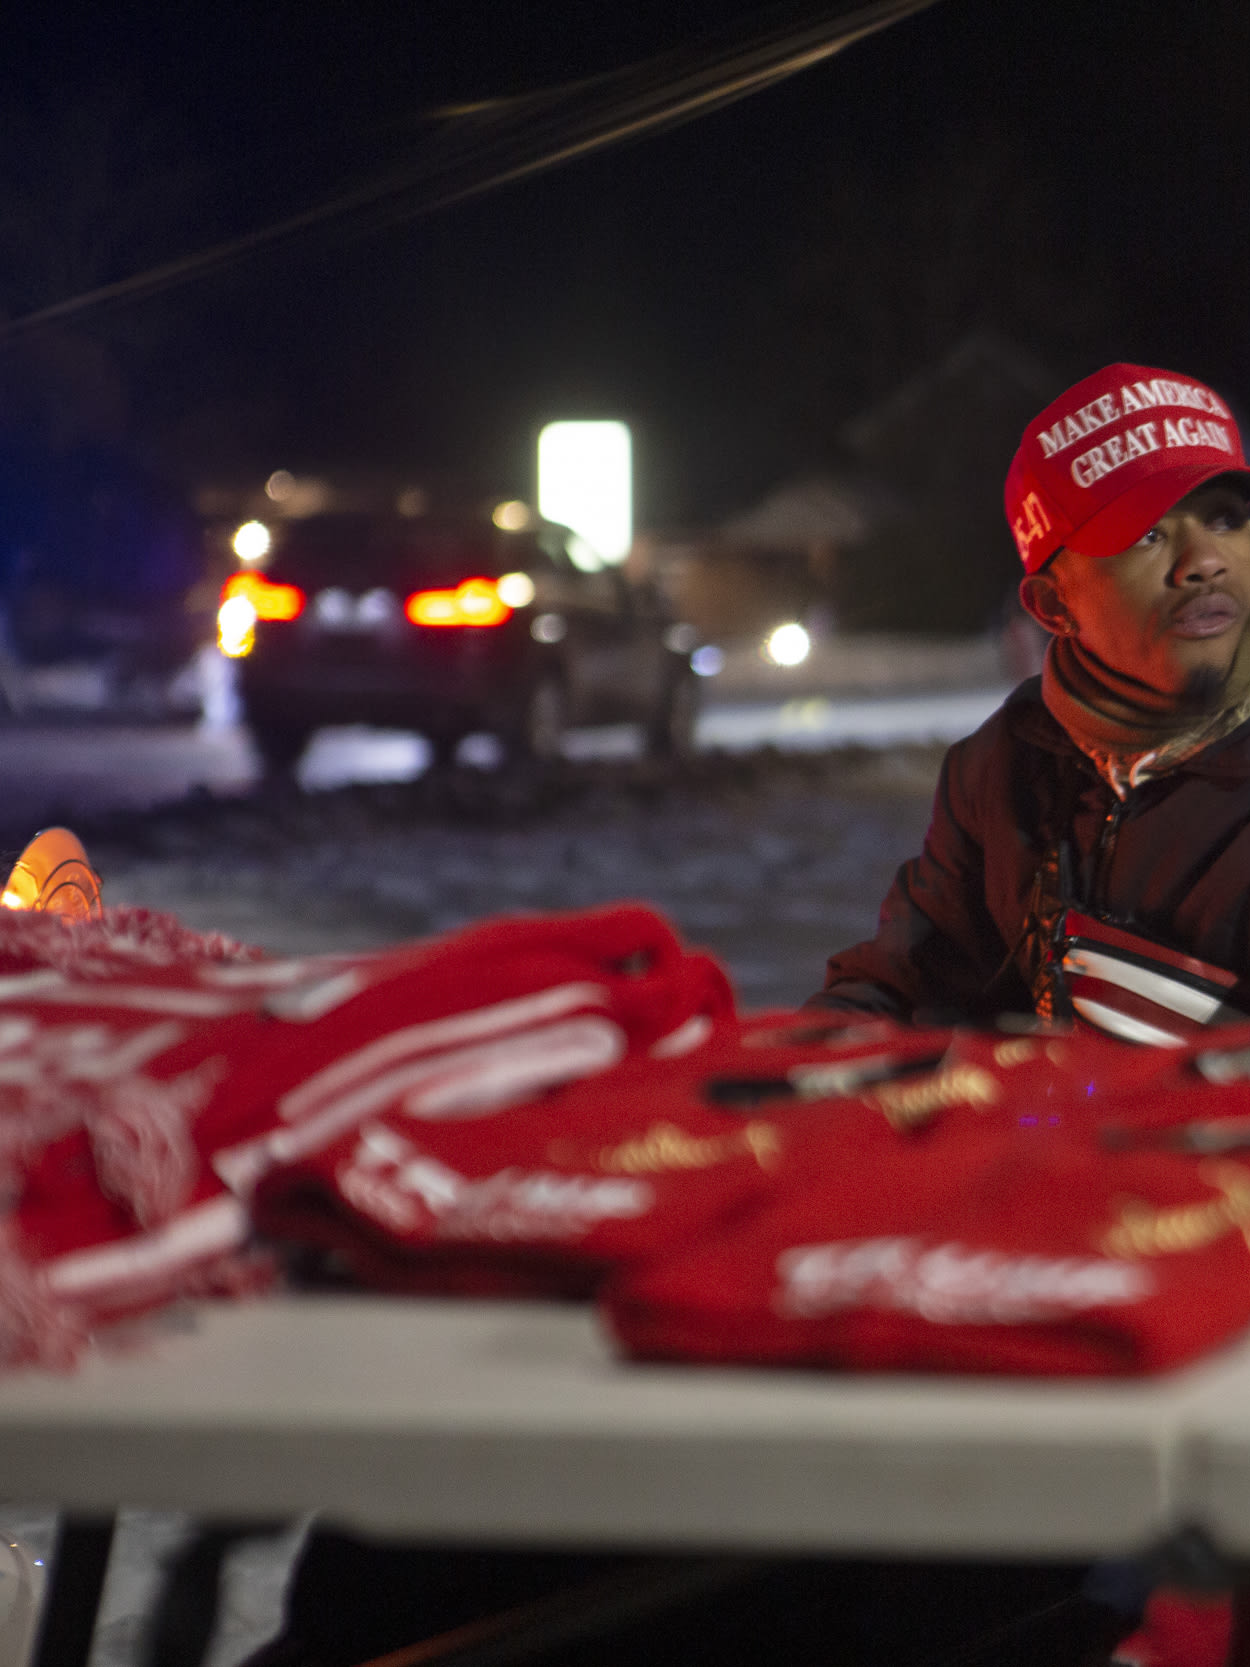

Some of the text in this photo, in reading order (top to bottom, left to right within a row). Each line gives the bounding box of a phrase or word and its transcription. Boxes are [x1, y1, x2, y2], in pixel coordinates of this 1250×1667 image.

[1037, 379, 1231, 458] MAKE AMERICA
[1071, 417, 1233, 488] GREAT AGAIN
